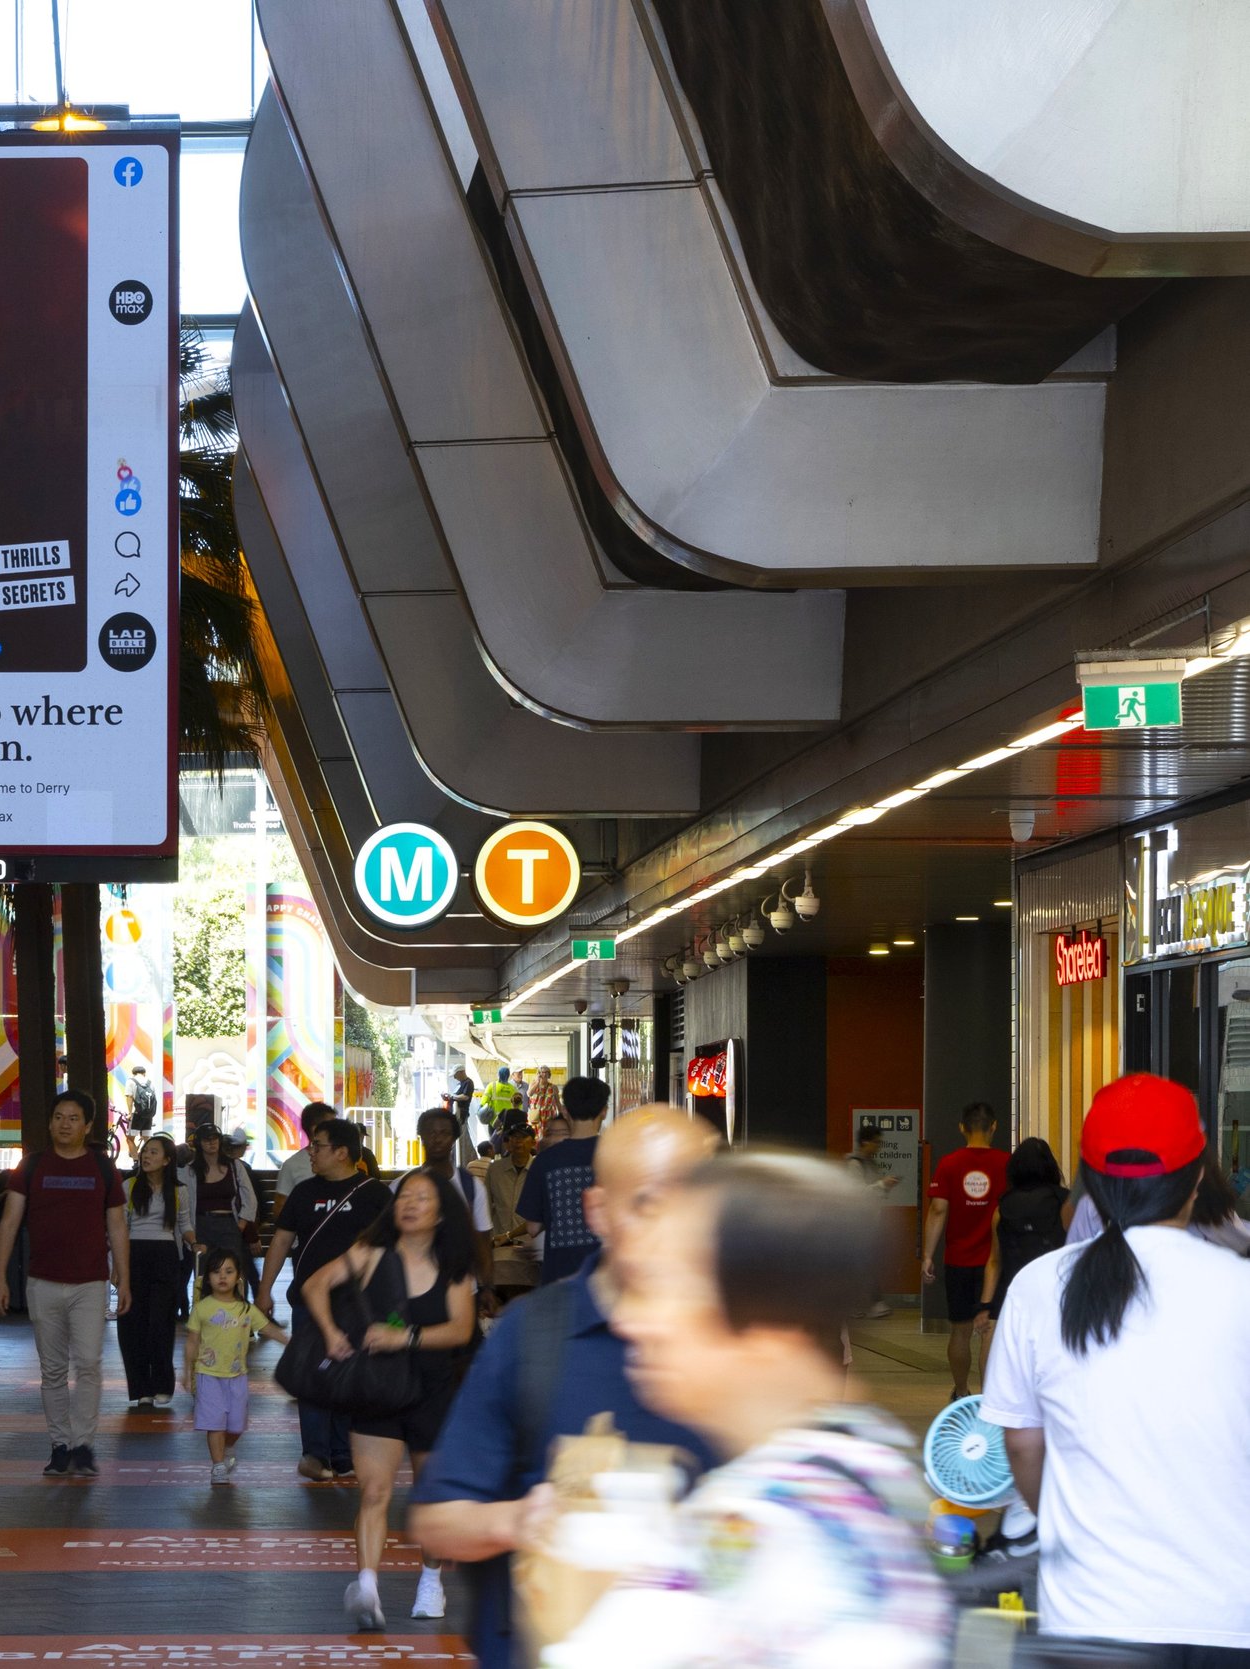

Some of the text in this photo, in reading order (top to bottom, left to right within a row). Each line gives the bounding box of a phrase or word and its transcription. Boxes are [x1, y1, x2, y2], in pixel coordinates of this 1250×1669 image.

[115, 291, 146, 305] HBO
[115, 304, 145, 315] max
[1, 545, 61, 570] THRILLS
[2, 581, 67, 606] SECRETS
[108, 629, 147, 639] LAD
[111, 639, 144, 647] BIBLE
[10, 695, 124, 726] where
[19, 783, 33, 795] to
[36, 782, 70, 797] Derry
[232, 821, 257, 829] Thoma
[380, 846, 433, 902] M
[506, 848, 550, 905] T
[879, 1151, 912, 1160] children
[73, 1643, 416, 1651] Amazon
